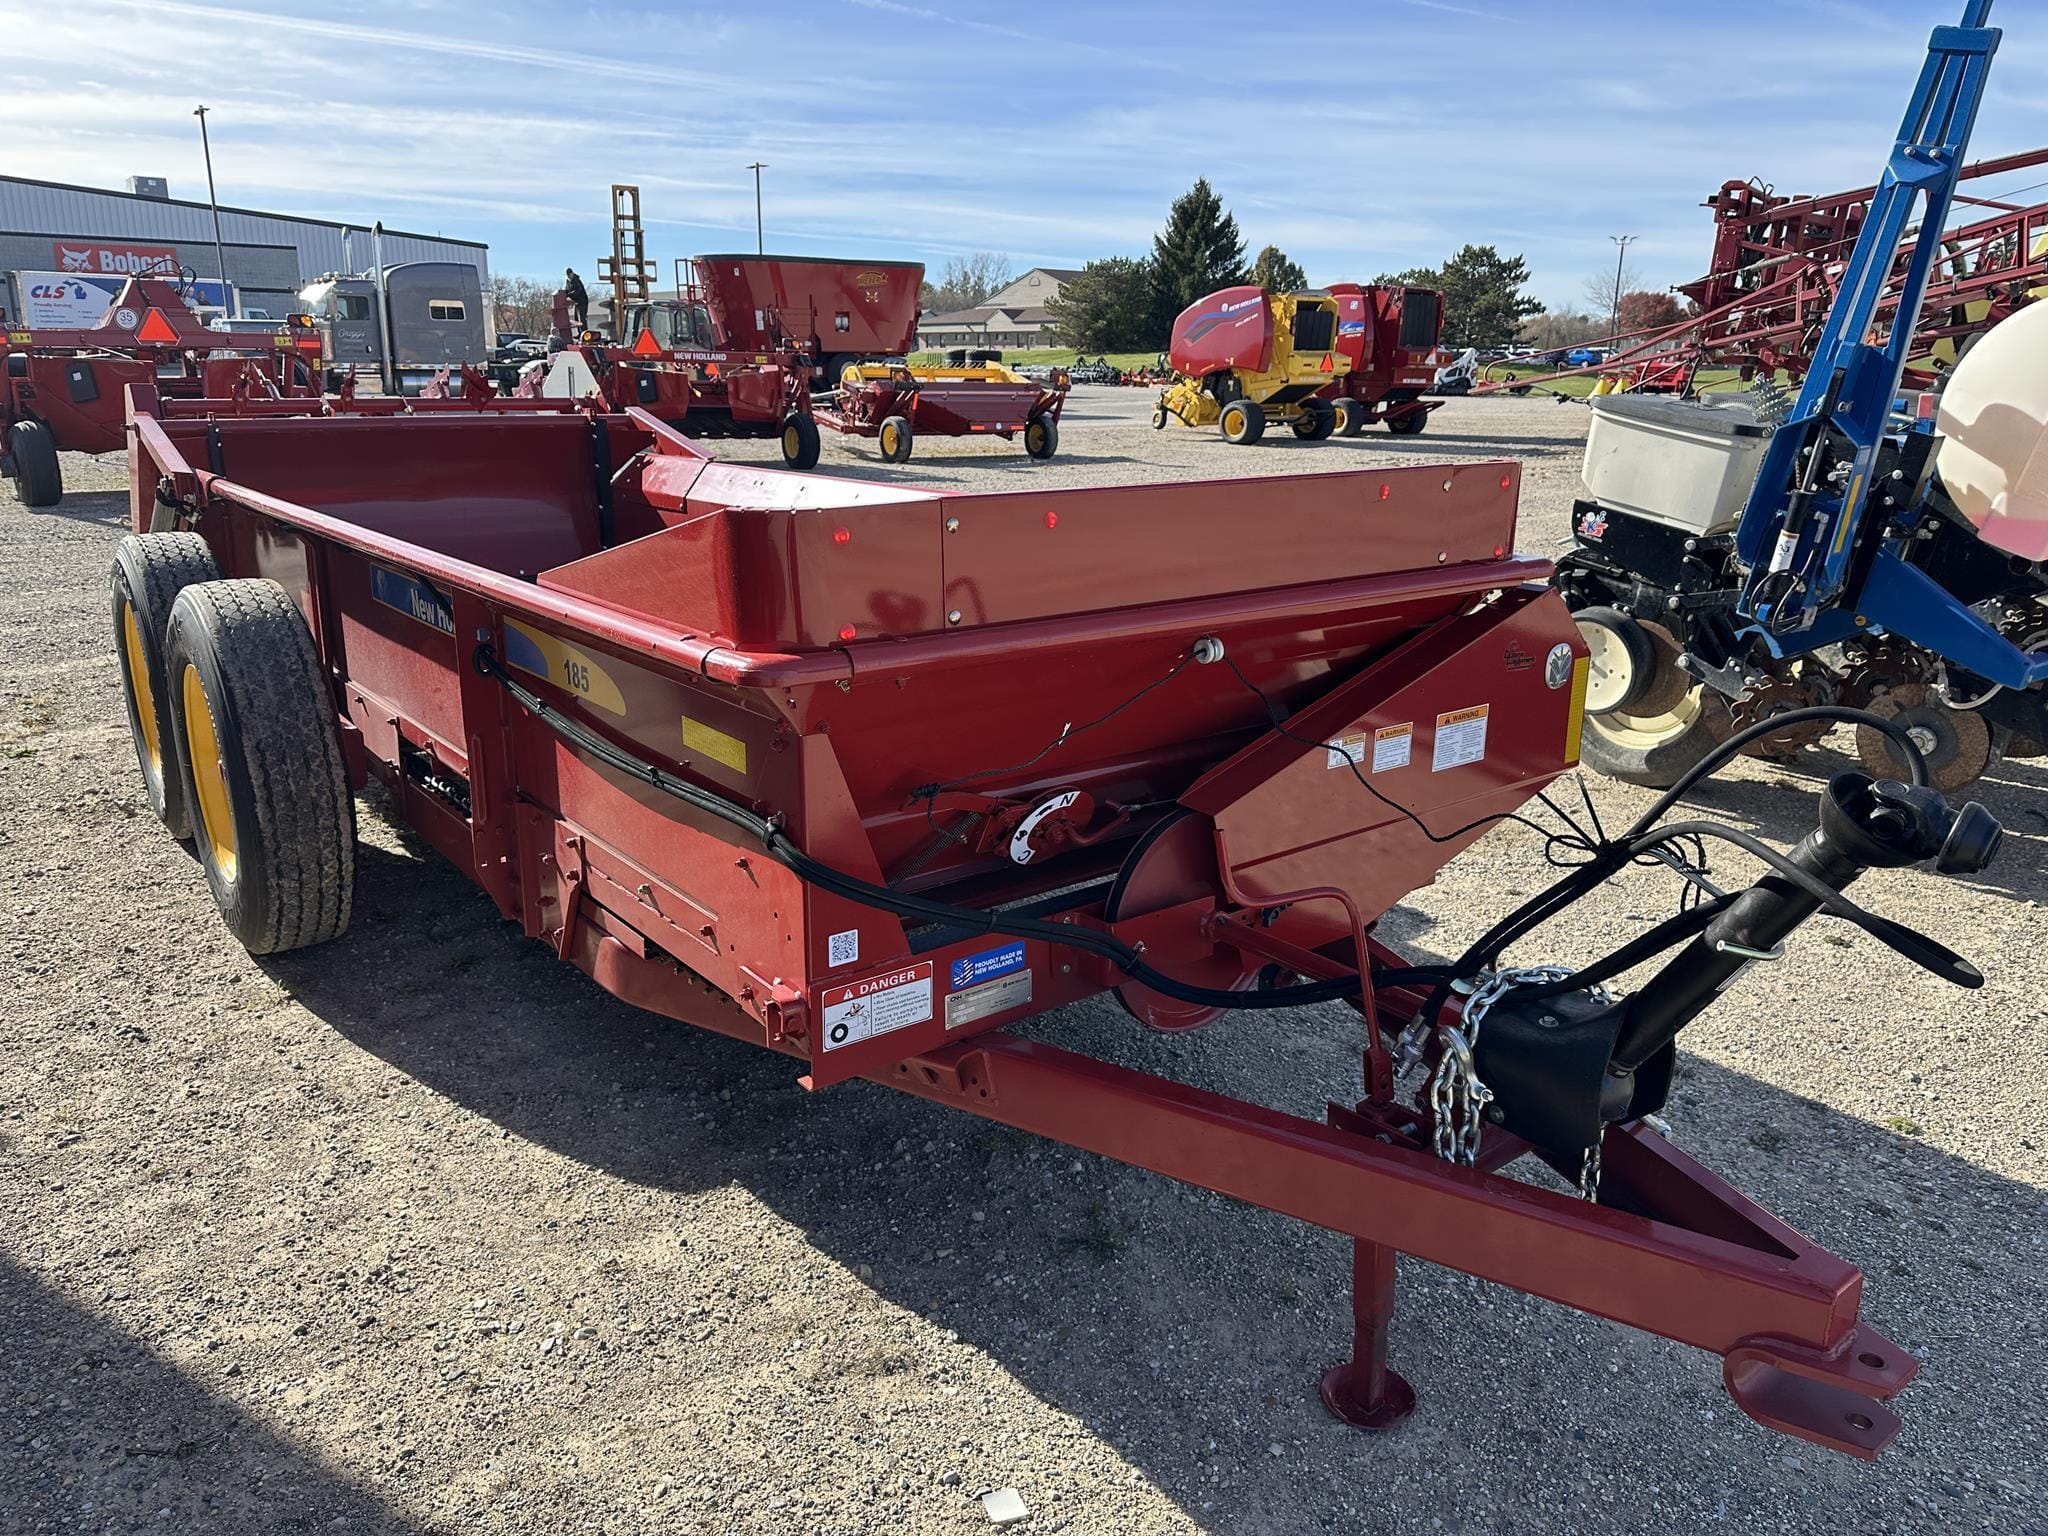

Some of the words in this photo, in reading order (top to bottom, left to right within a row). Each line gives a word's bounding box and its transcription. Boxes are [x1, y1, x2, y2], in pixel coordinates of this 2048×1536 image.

[99, 250, 174, 273] Bobcat
[31, 285, 66, 299] CLS
[120, 312, 133, 321] 35
[674, 352, 691, 360] NEW
[692, 352, 727, 361] HOLLAND
[410, 588, 434, 624] New
[564, 659, 589, 692] 185
[1453, 710, 1479, 721] WARNING
[1385, 727, 1409, 736] WARNING
[1060, 793, 1075, 806] N
[975, 957, 999, 968] PROUDLY
[1000, 952, 1015, 961] MADE
[975, 967, 987, 975] NEW
[988, 959, 1014, 971] HOLLAND,
[860, 971, 916, 995] DANGER
